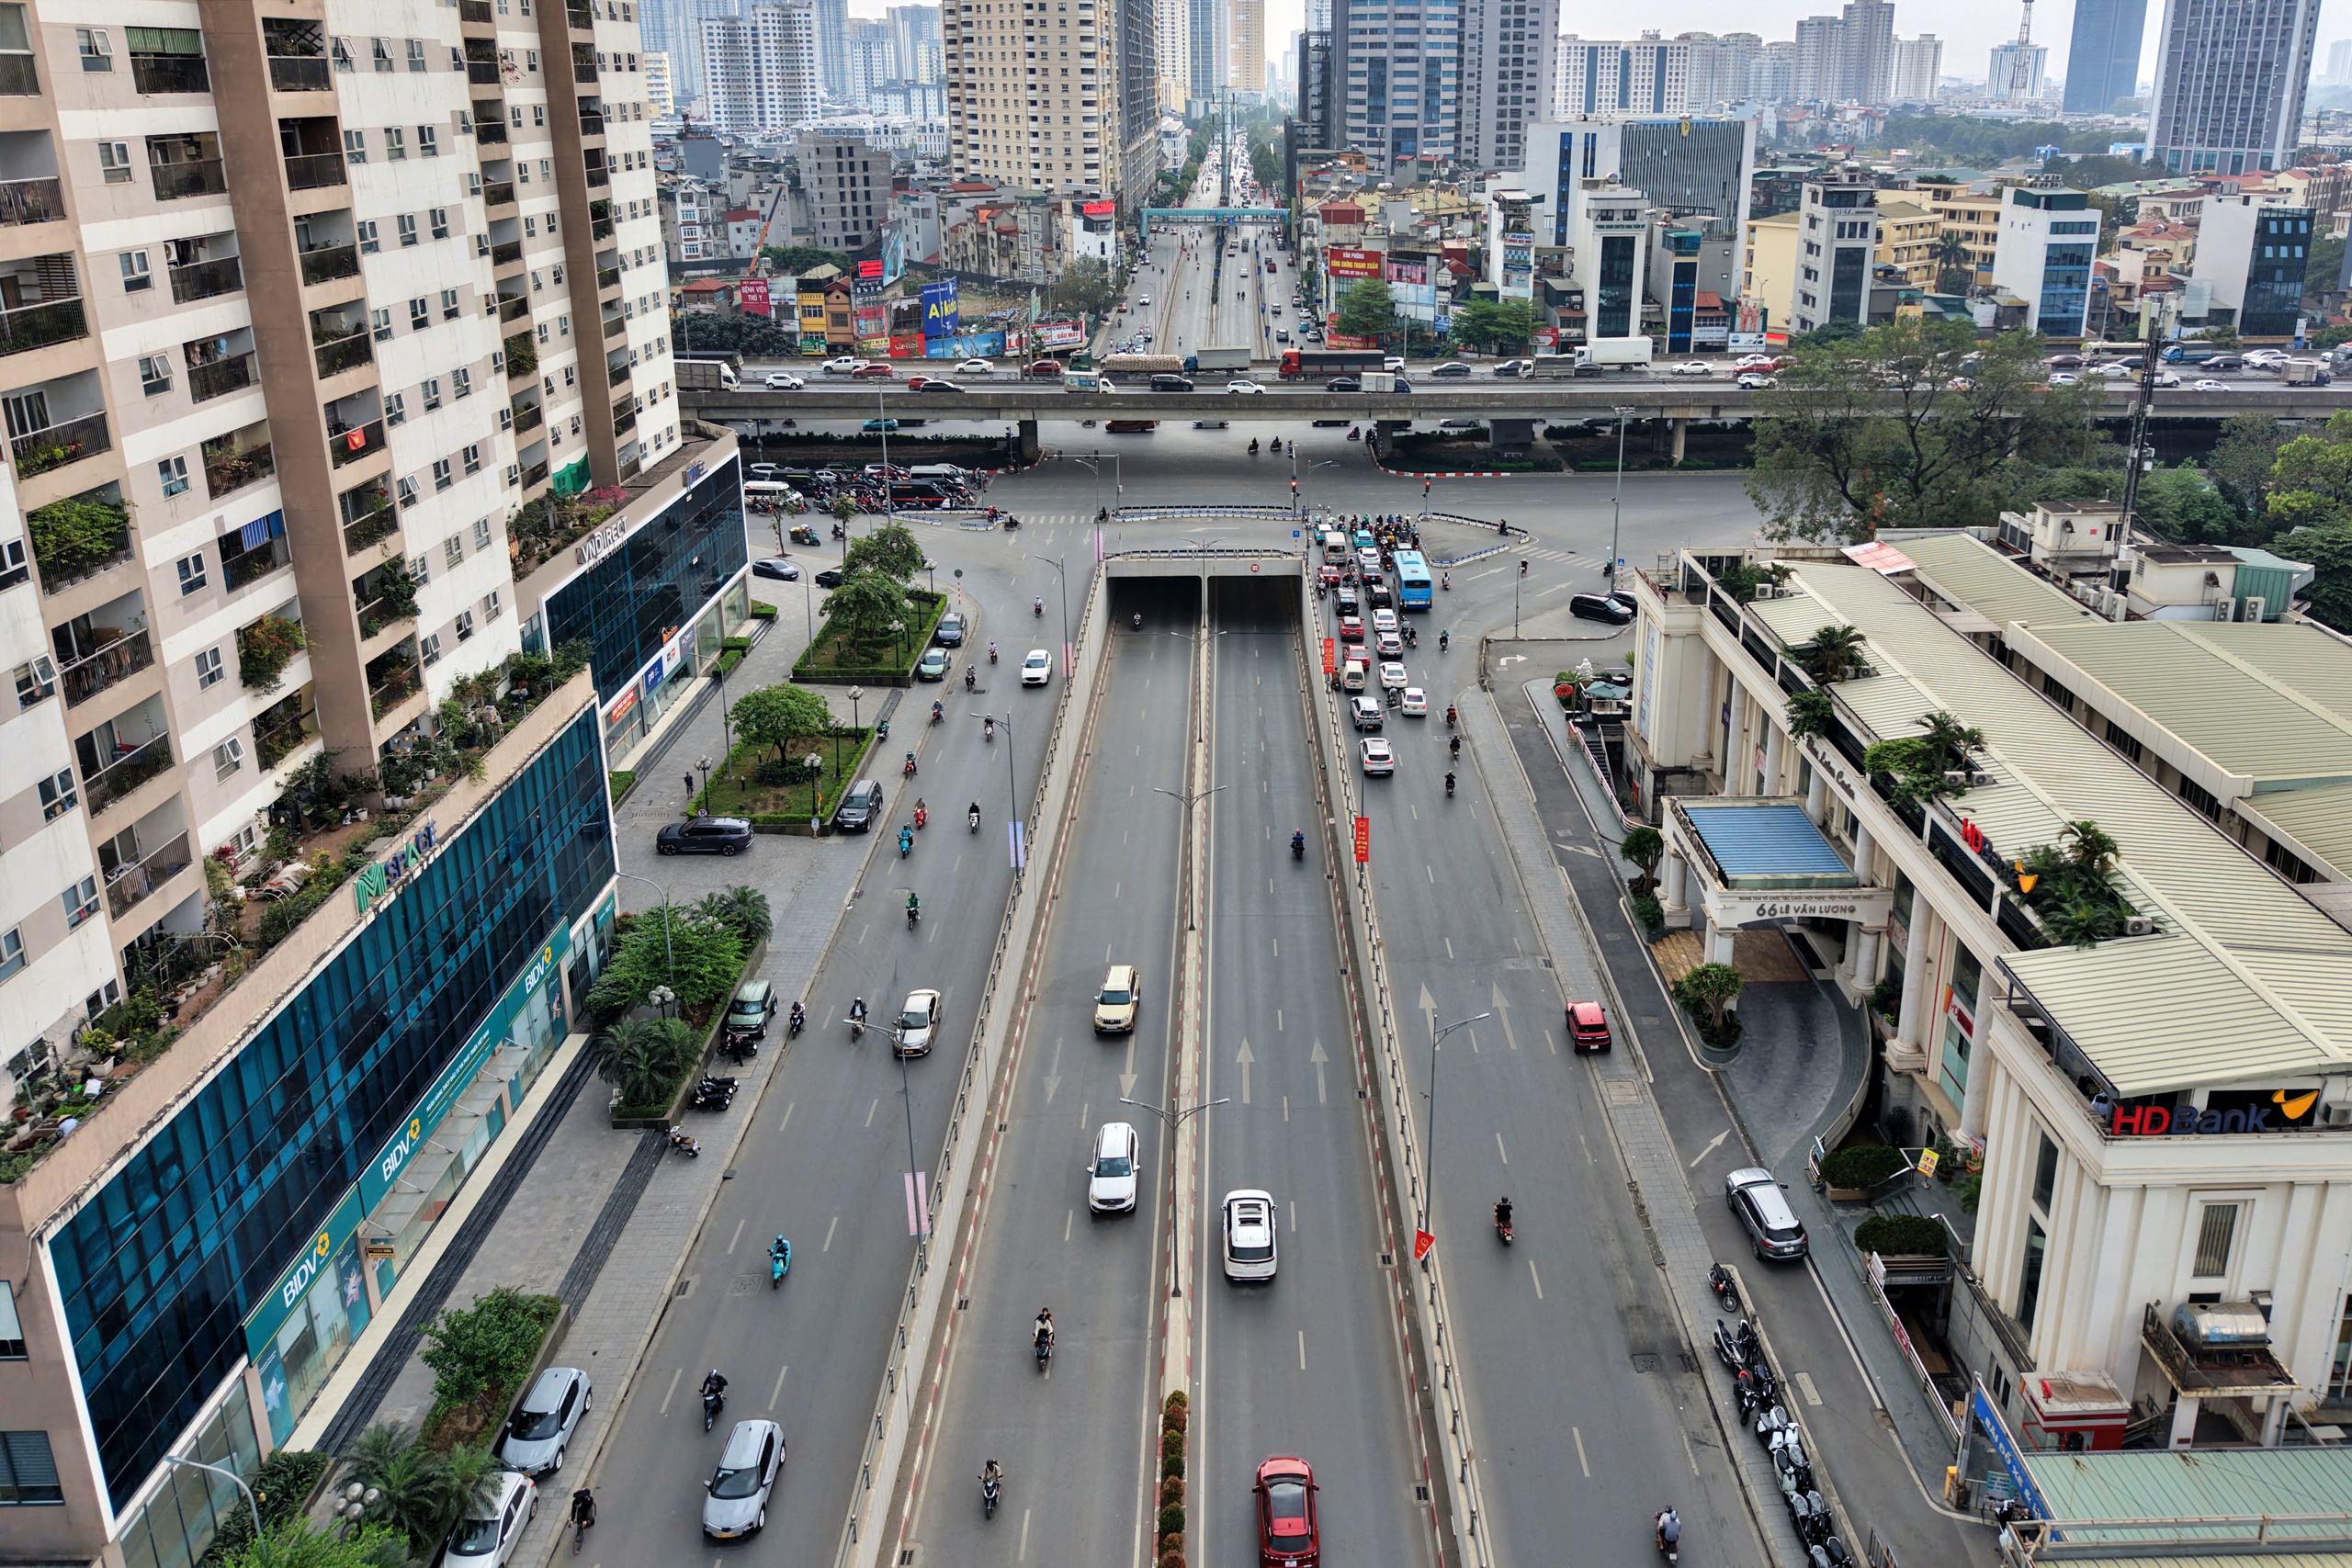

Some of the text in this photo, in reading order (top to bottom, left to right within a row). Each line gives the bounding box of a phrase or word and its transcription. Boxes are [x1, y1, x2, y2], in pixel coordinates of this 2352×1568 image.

[582, 515, 628, 562] VNDIRECT
[1756, 903, 1856, 917] 66 LÊ VĂN LƯƠNG
[525, 955, 545, 994] BIDV
[2113, 1103, 2271, 1135] HDBank
[381, 1130, 411, 1182] BIDV
[283, 1247, 317, 1309] BIDV
